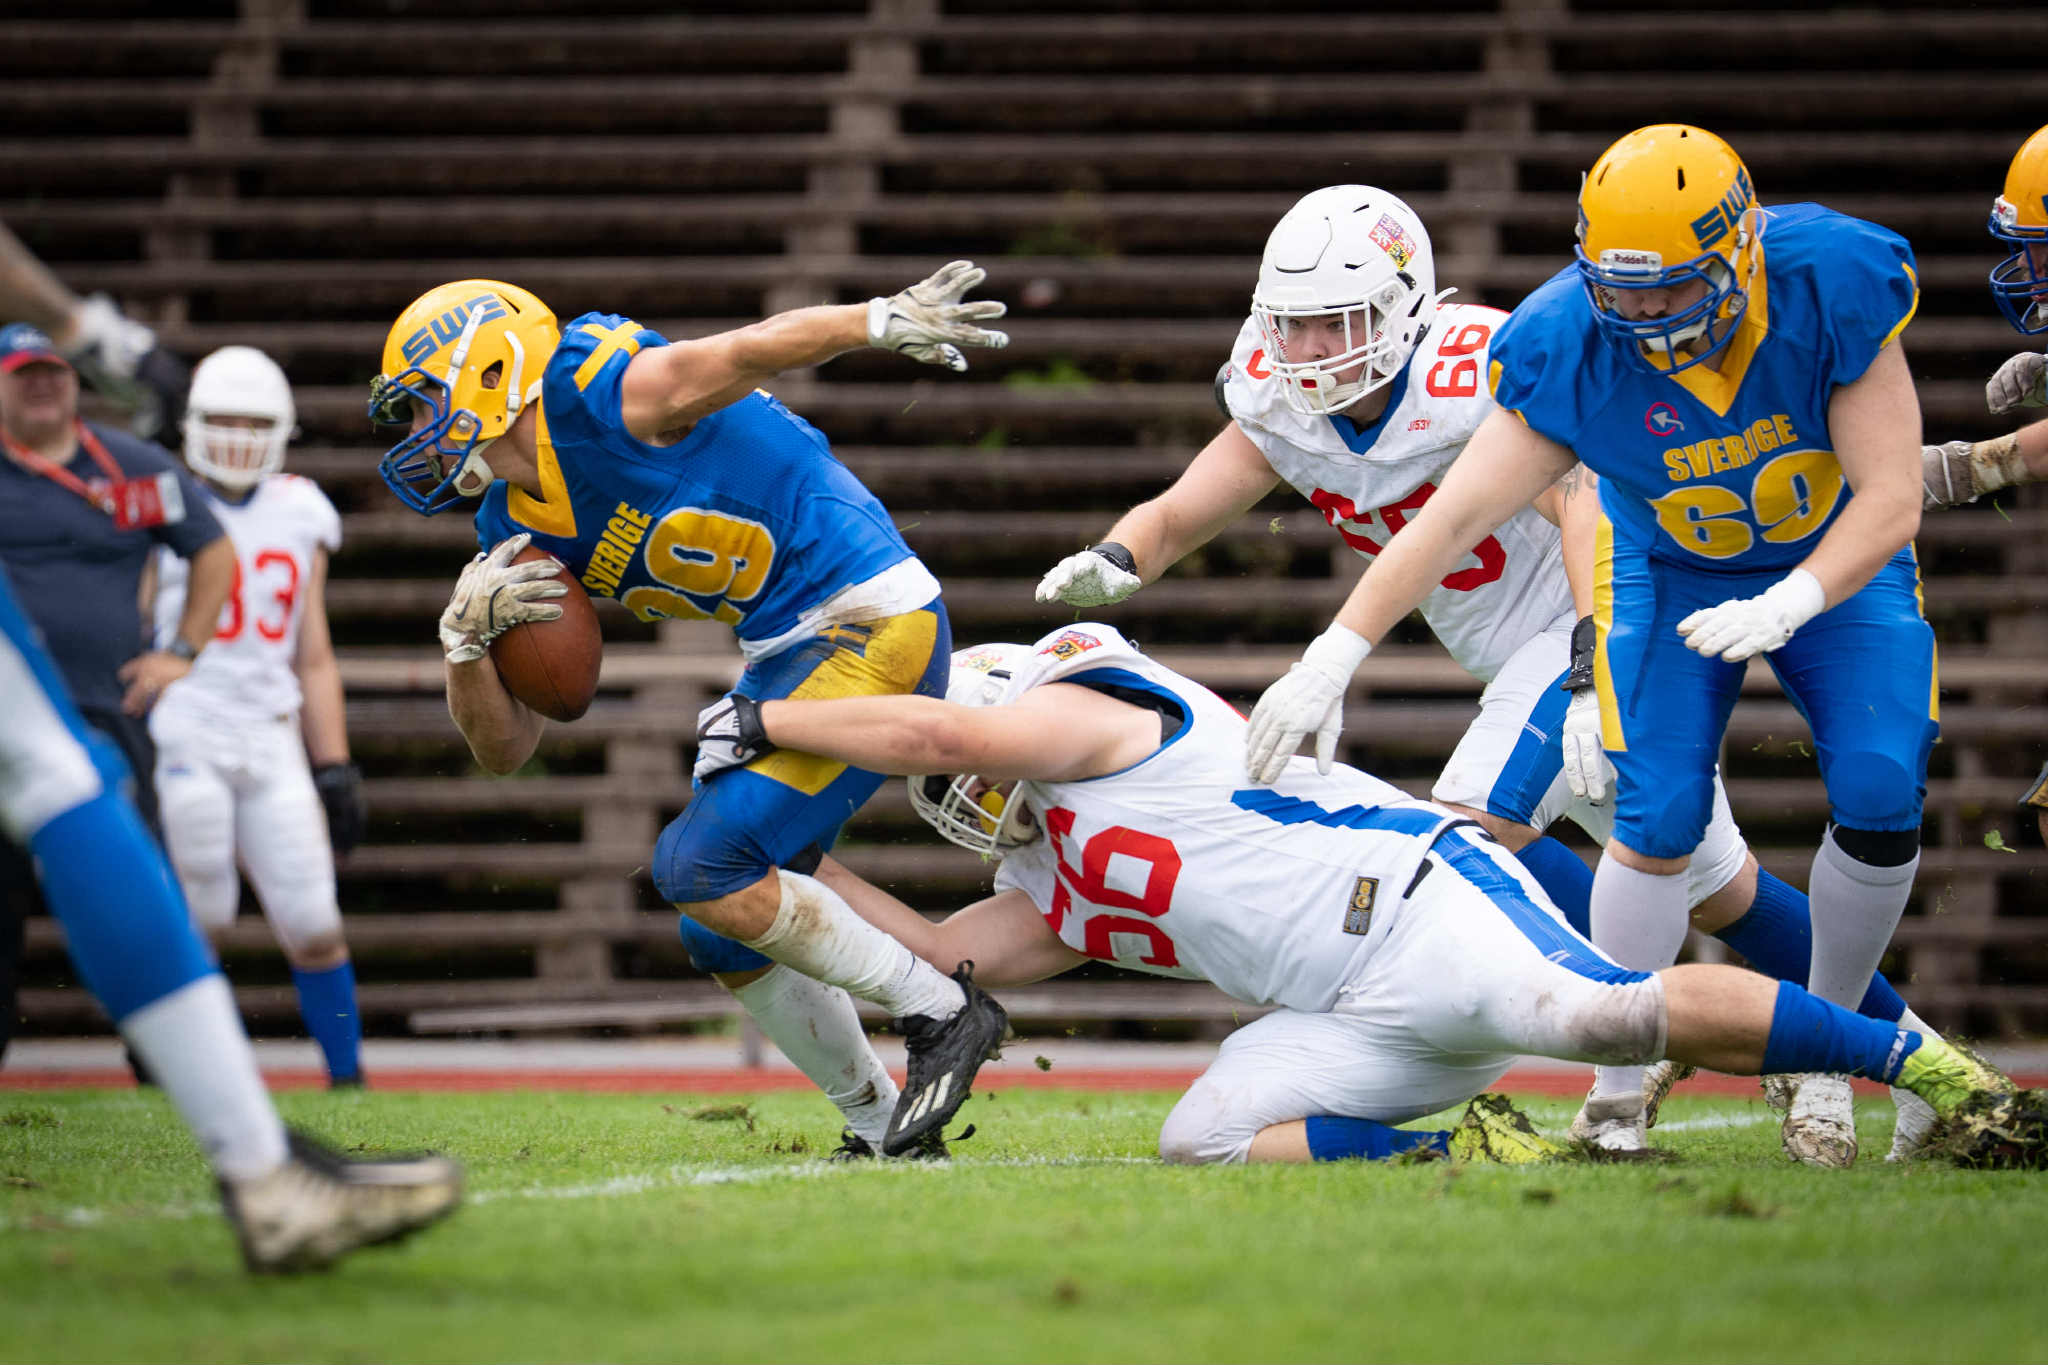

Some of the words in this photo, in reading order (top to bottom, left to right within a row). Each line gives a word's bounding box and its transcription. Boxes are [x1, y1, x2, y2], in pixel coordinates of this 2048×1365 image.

[1690, 164, 1753, 251] SWE
[401, 293, 507, 367] SWE
[1426, 323, 1491, 397] 66
[1663, 414, 1798, 481] SVERIGE
[1645, 449, 1843, 559] 69
[581, 501, 652, 597] SVERIGE
